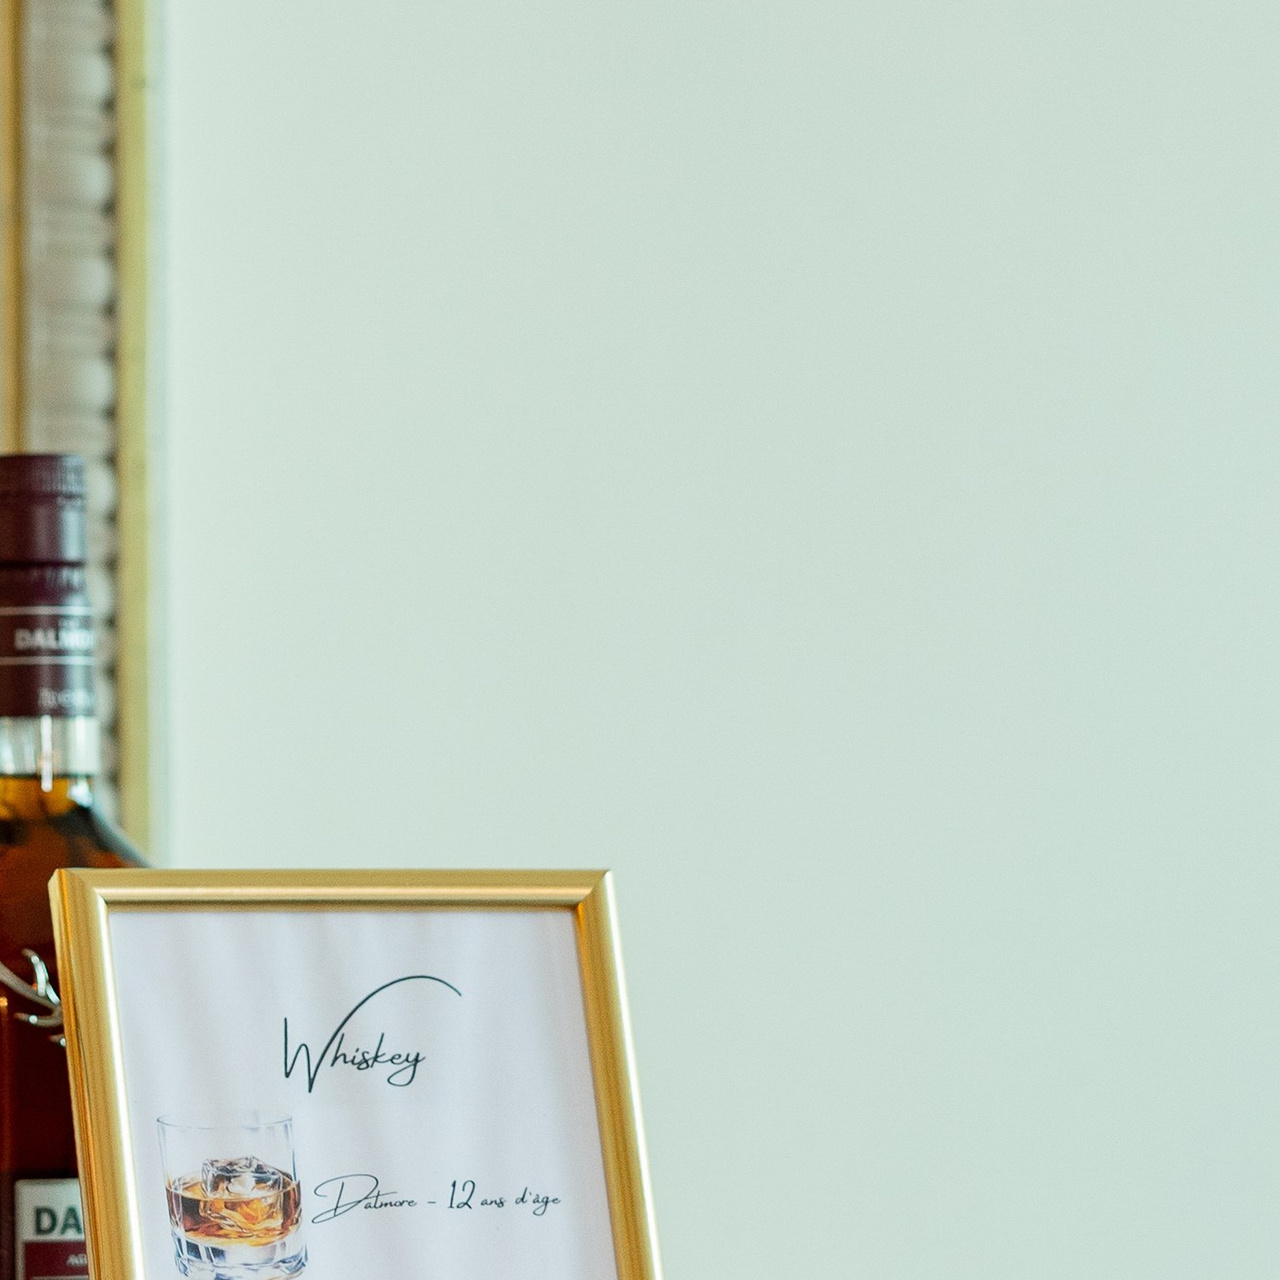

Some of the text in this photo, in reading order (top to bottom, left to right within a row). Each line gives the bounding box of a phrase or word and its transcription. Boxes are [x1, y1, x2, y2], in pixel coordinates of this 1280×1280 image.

[282, 974, 463, 1094] Whiskey
[448, 1179, 477, 1210] 12
[480, 1195, 507, 1209] ans
